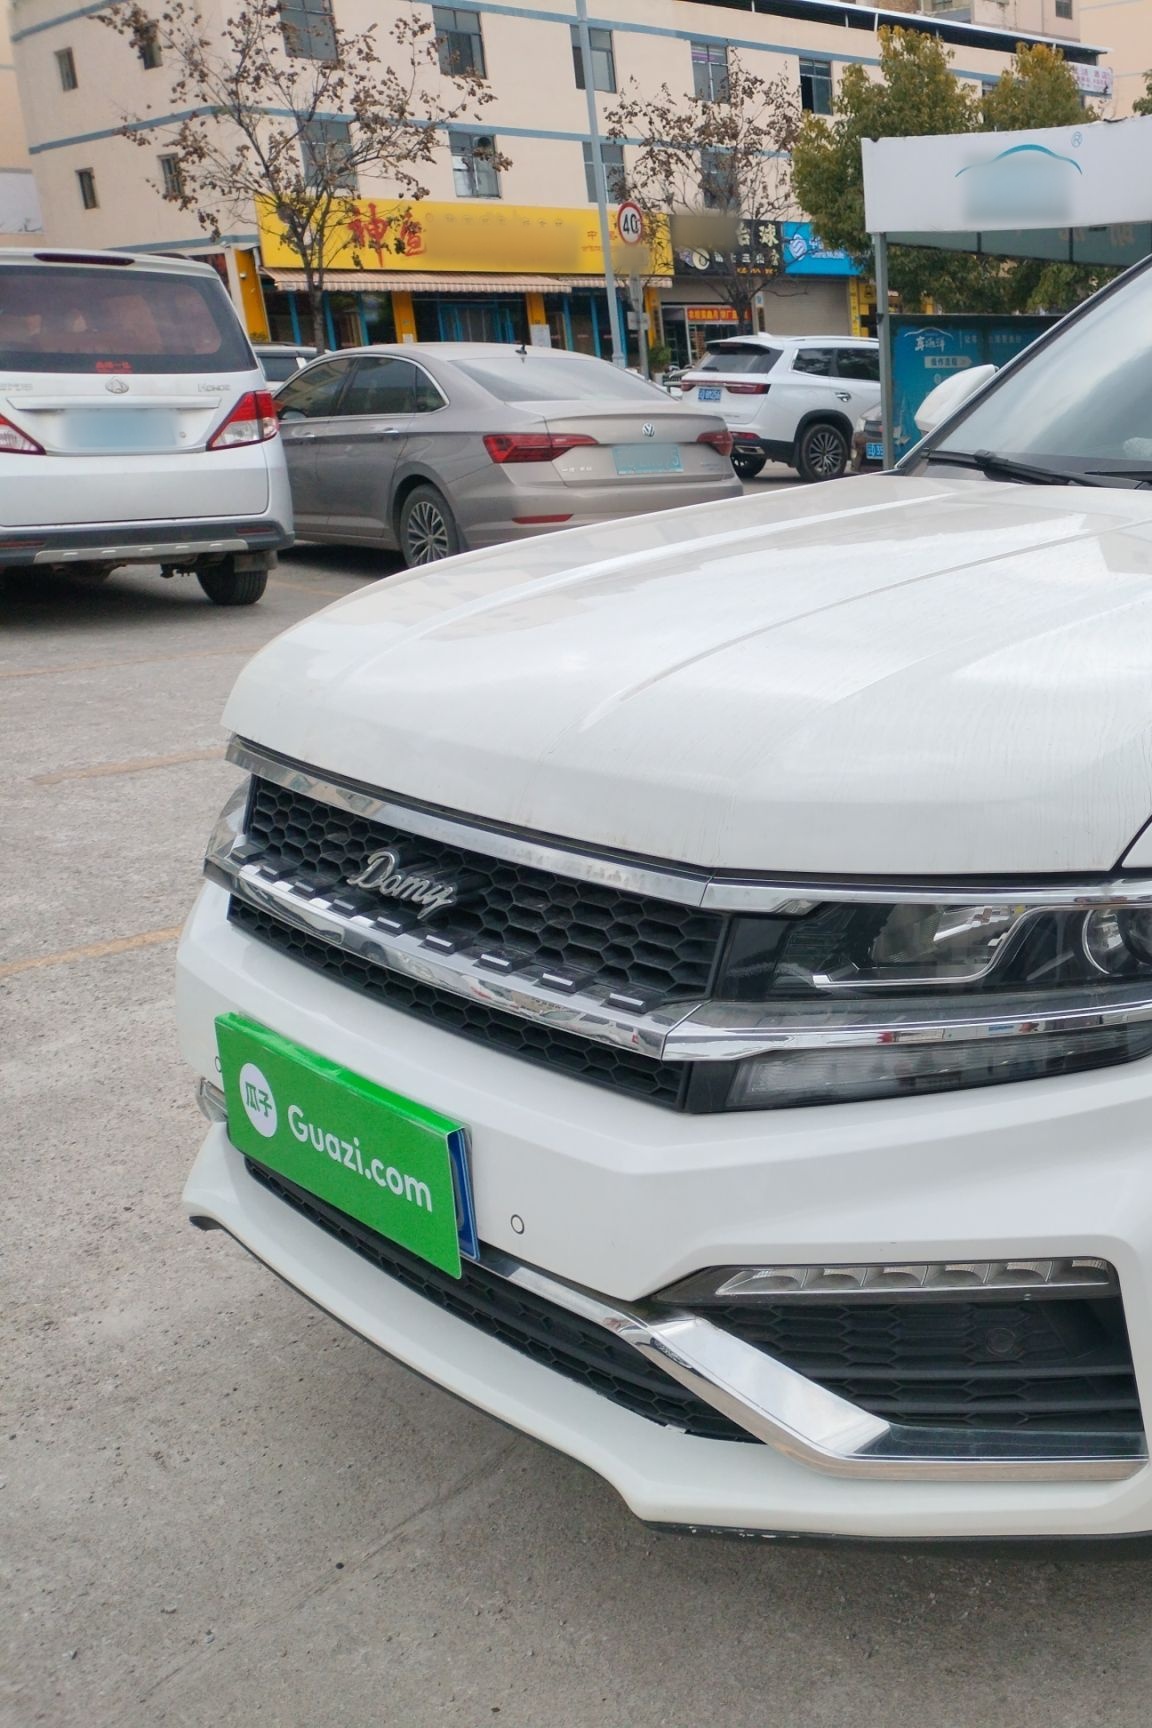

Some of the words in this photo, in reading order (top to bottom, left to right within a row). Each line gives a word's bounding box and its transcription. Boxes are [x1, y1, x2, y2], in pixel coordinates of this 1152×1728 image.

[623, 213, 640, 235] 40
[245, 1082, 273, 1118] 瓜子
[288, 1104, 433, 1213] Guazi.com
